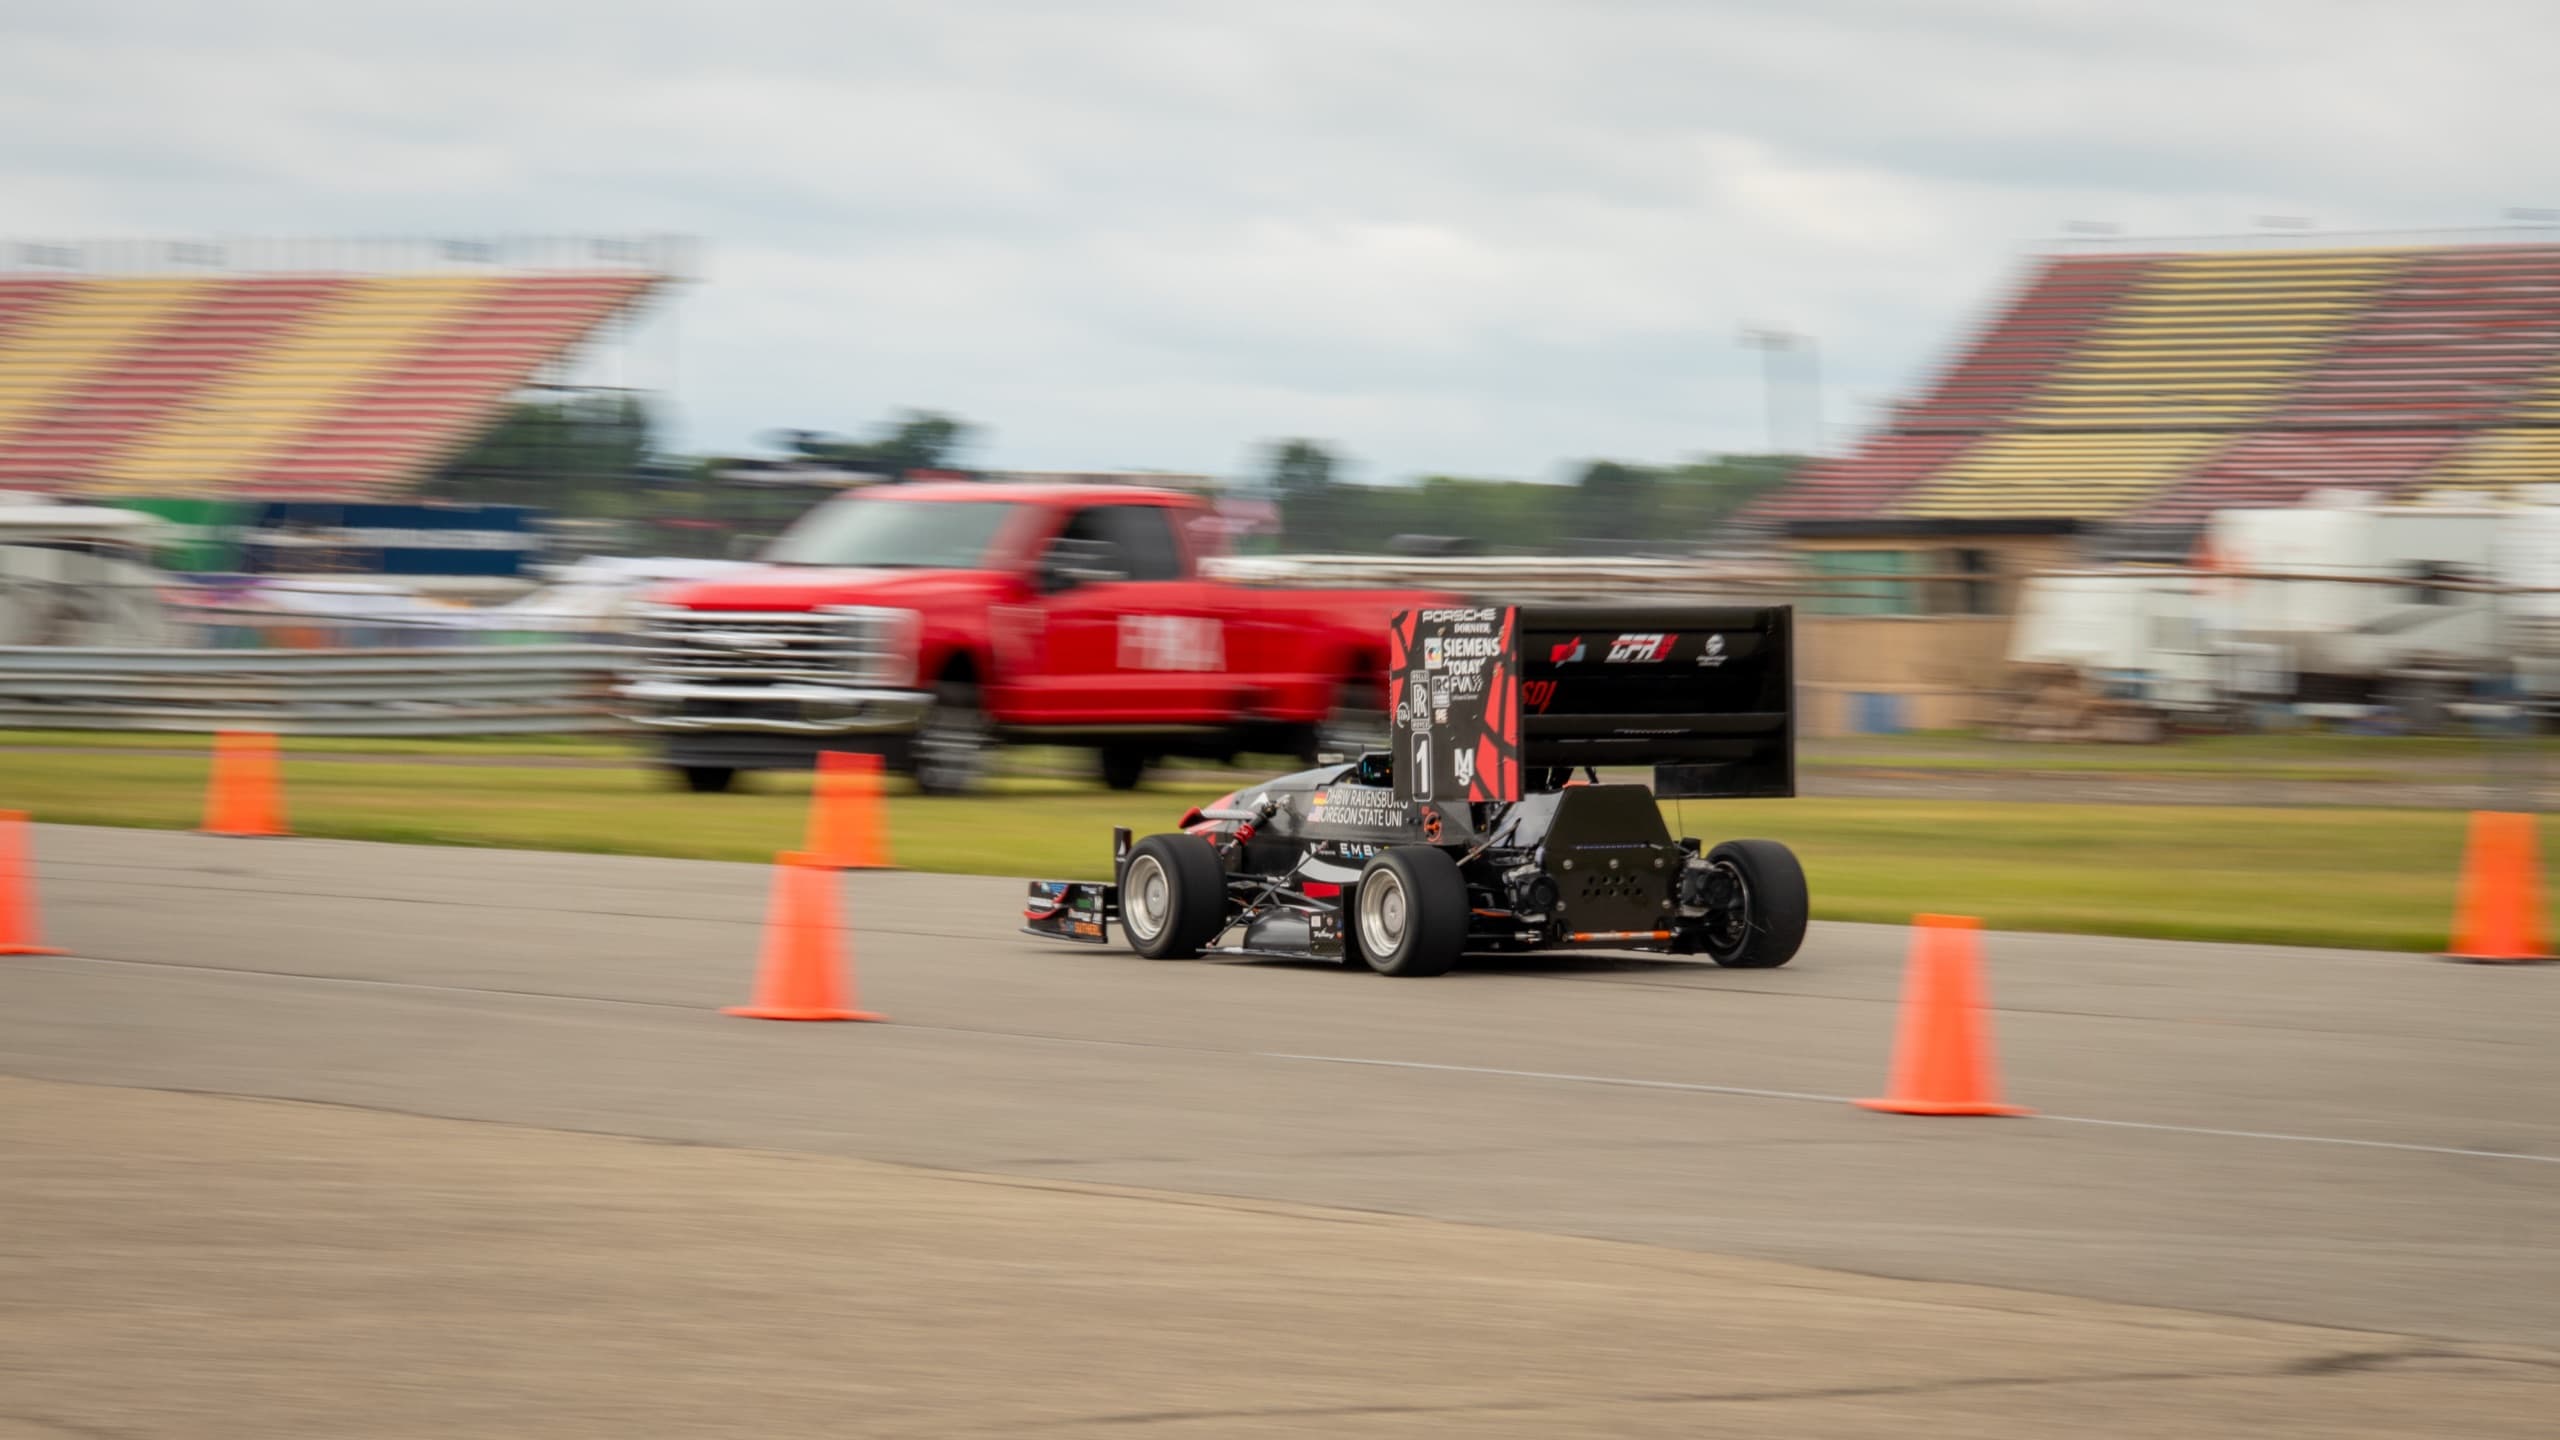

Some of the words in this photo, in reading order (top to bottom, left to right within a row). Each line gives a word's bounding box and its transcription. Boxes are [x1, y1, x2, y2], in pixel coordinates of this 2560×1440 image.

[1422, 608, 1497, 623] PORSCHE
[1443, 637, 1500, 657] SIEMENS
[1416, 739, 1429, 793] 1
[1320, 806, 1358, 824] OREGON
[1358, 808, 1384, 826] STATE
[1385, 810, 1402, 828] UNI
